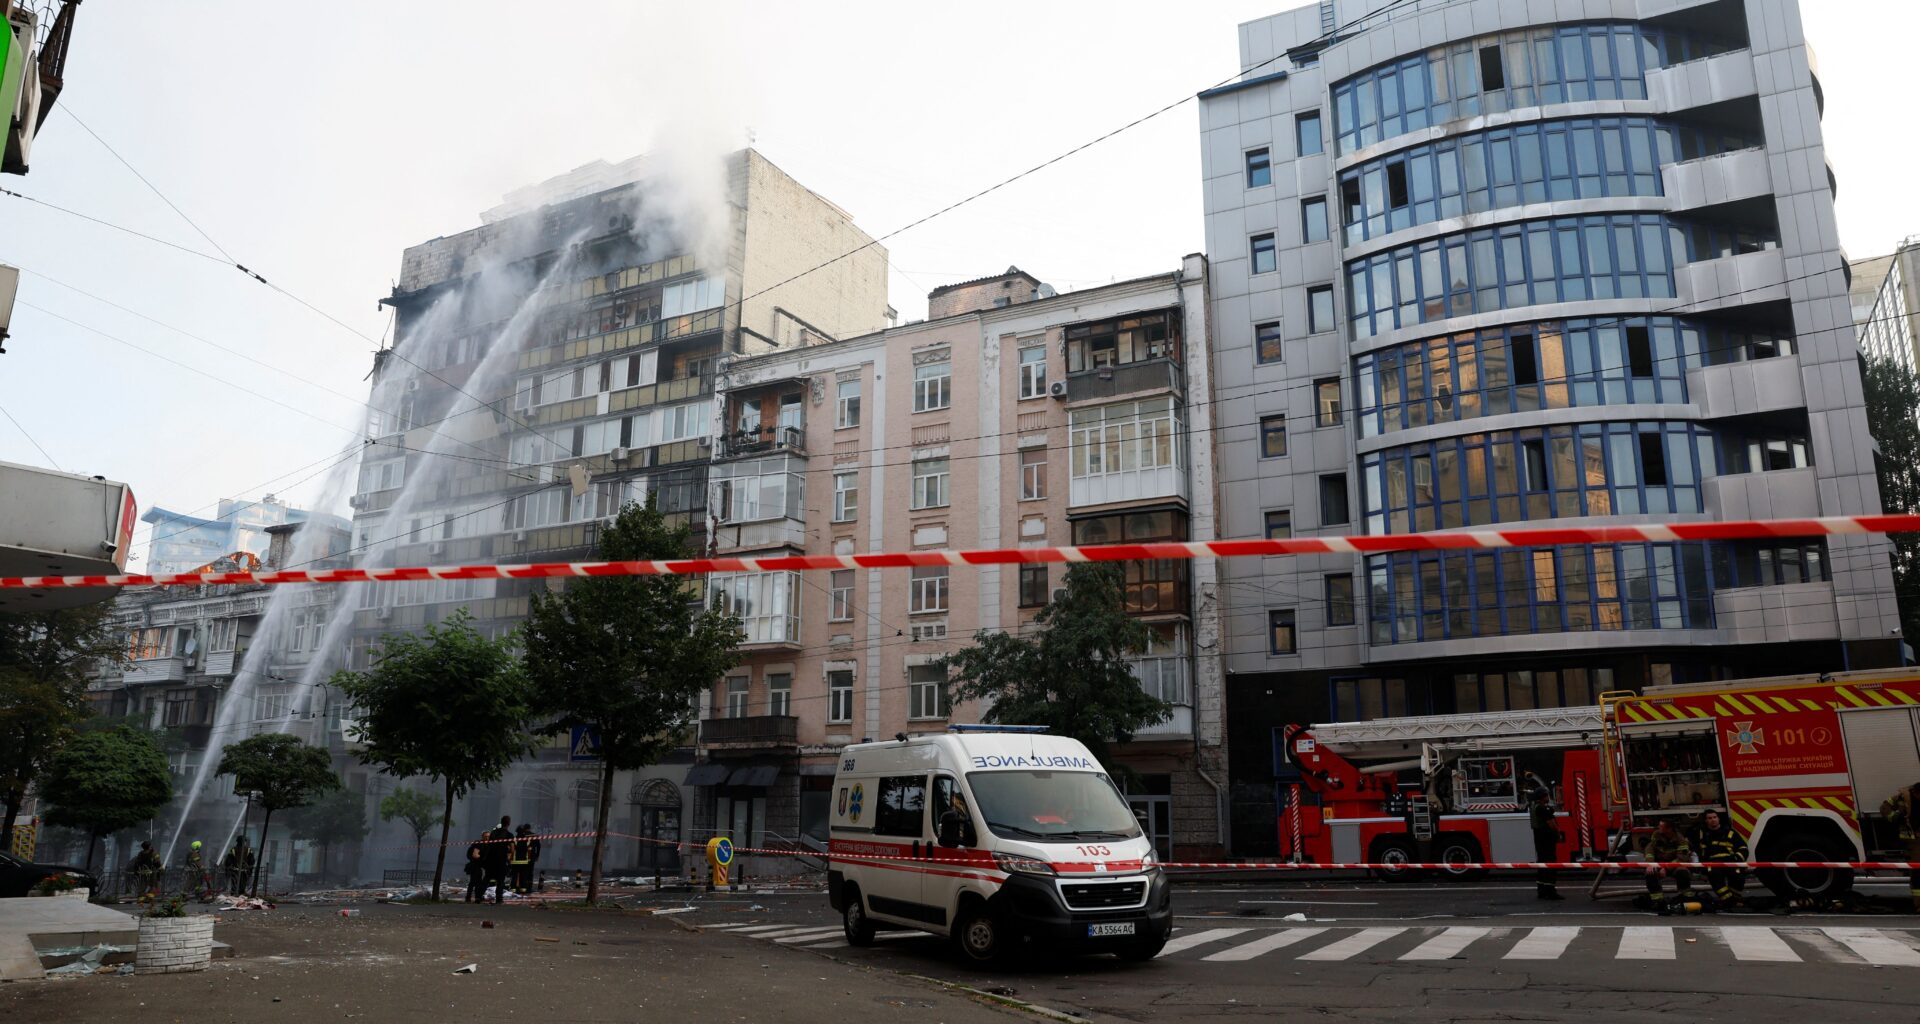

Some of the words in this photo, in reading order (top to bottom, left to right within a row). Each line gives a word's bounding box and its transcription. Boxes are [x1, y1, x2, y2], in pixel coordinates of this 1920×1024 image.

[1772, 728, 1805, 746] 101
[843, 758, 856, 772] 368
[1735, 758, 1771, 767] ДЕРЖАВНА
[1773, 756, 1802, 764] СЛУЖБА
[1802, 754, 1833, 762] УКРАЇНИ
[1076, 845, 1111, 856] 103
[1092, 926, 1103, 935] KA
